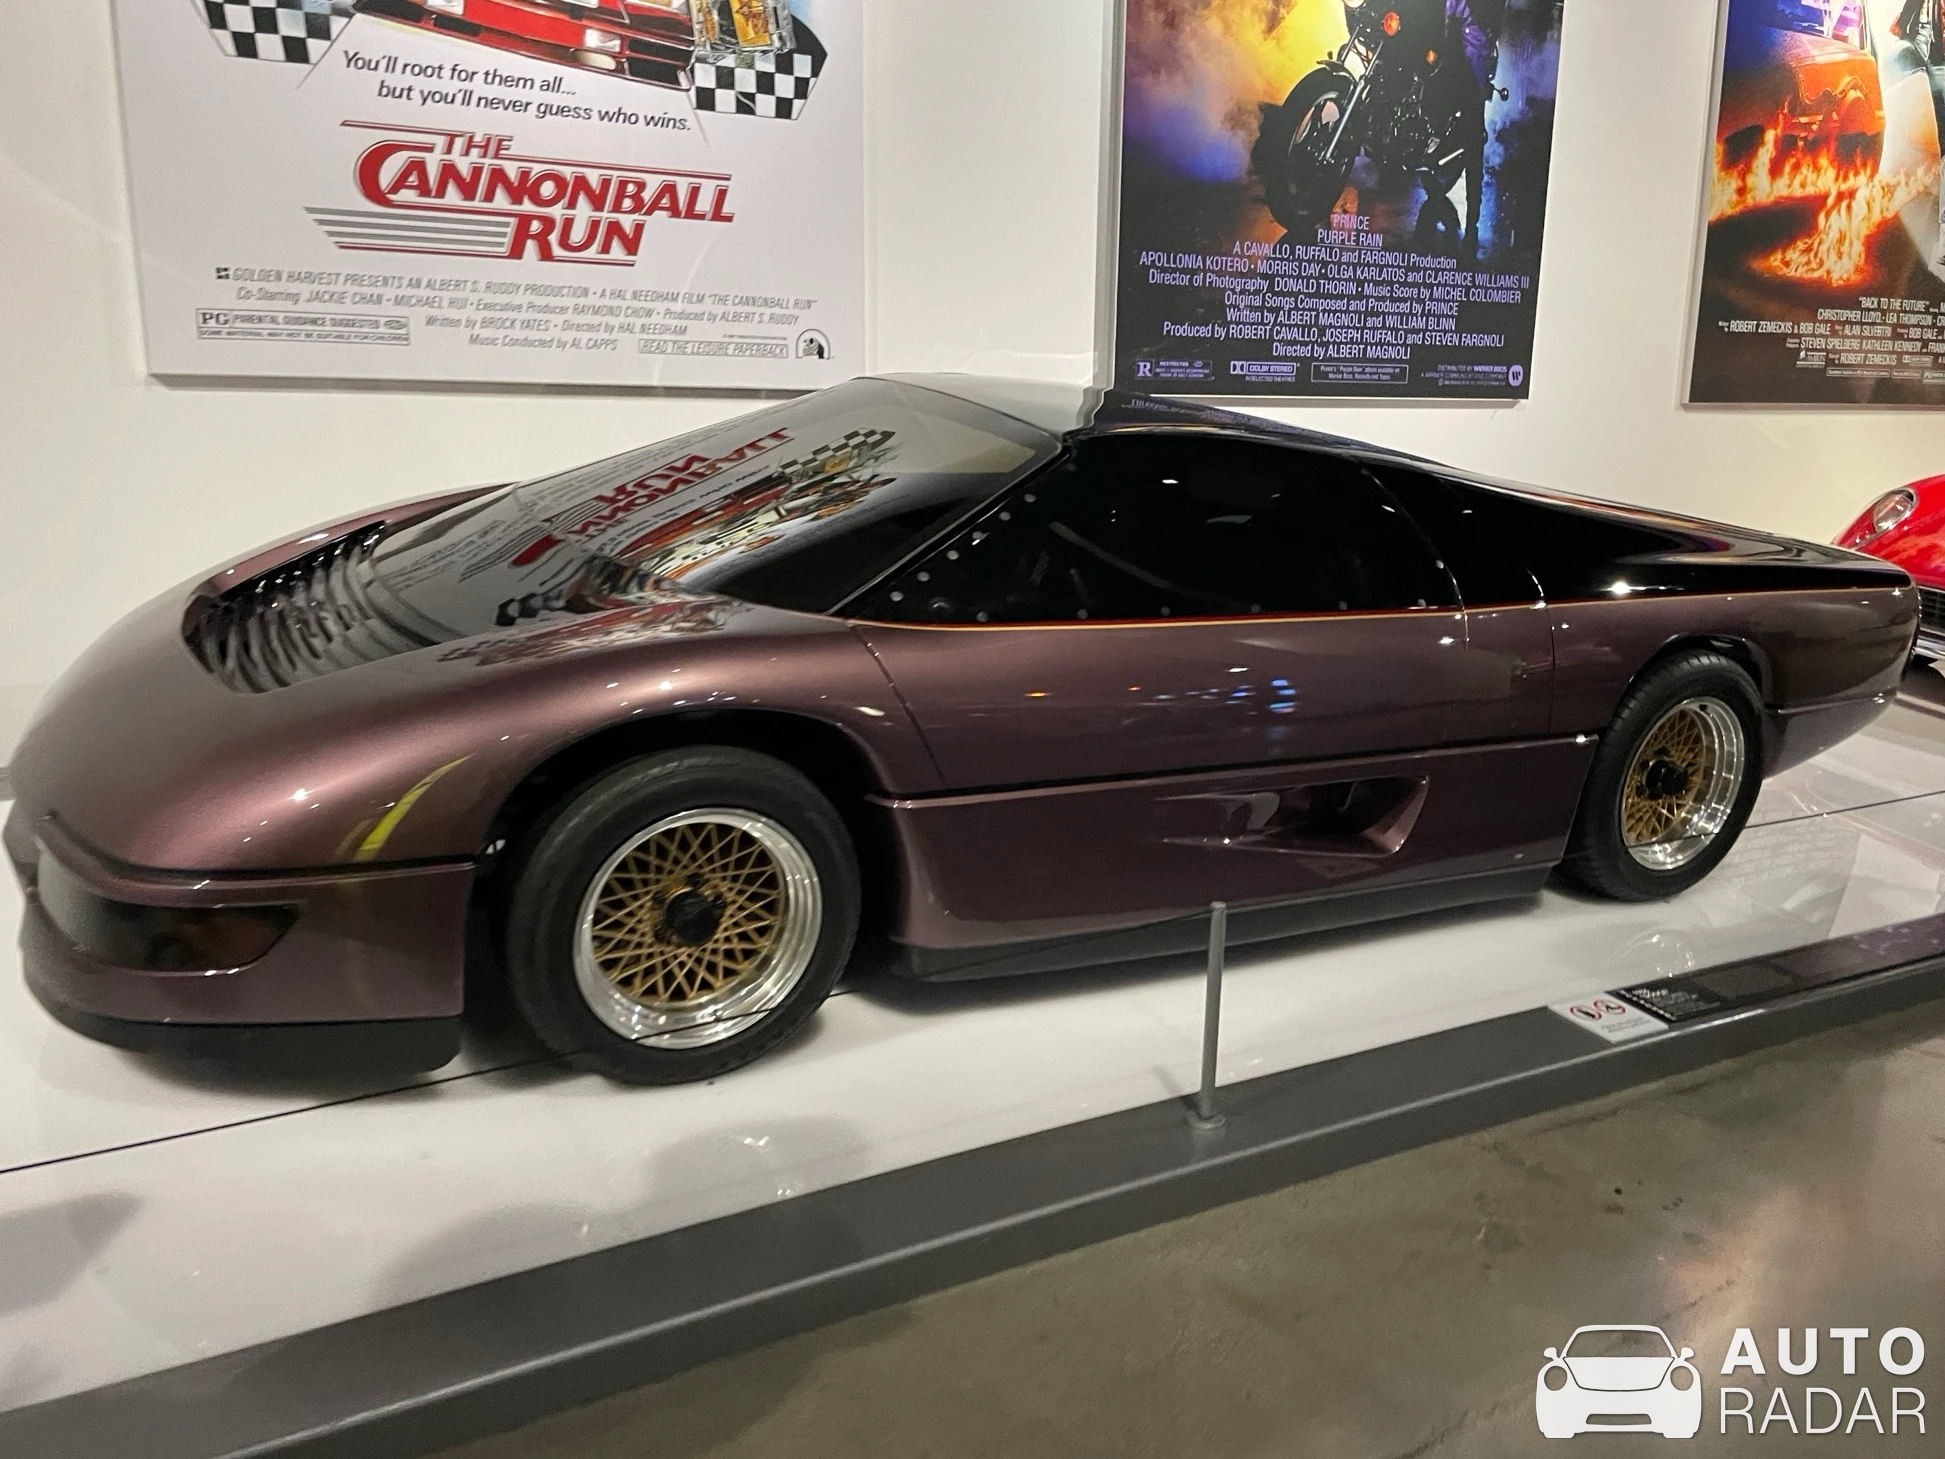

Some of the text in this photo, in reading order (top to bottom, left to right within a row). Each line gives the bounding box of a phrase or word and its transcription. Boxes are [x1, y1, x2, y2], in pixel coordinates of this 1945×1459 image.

[402, 63, 444, 80] root
[450, 64, 478, 84] for
[482, 70, 534, 91] them
[539, 75, 577, 96] all...
[377, 80, 413, 101] but
[477, 95, 532, 114] never
[537, 103, 593, 120] guess
[598, 107, 640, 125] who
[644, 112, 692, 131] wins.
[441, 132, 513, 159] THE
[354, 139, 735, 222] CANNONBALL
[1333, 213, 1370, 231] PRINCE
[504, 212, 647, 262] RUN
[1317, 228, 1383, 247] PURPLE RAIN
[1233, 241, 1457, 269] A CAVALLO, RUFFALO and FARGNOLI Production
[1139, 251, 1530, 289] APOLLONIA KOTERO MORRIS DAY OLGA KARLATOS and CLARENCE WILLIAMS III
[231, 268, 282, 283] GOLDEN
[286, 271, 339, 286] HARVEST
[342, 272, 404, 289] PRESENTS
[406, 275, 423, 289] AN
[424, 275, 470, 292] ALBERT
[483, 281, 521, 295] RUDDY
[523, 283, 590, 298] PRODUCTION
[609, 288, 628, 301] HAL
[631, 289, 681, 304] NEEDHAM
[682, 292, 705, 305] FILM
[731, 295, 790, 310] CANNONBALL
[1149, 268, 1522, 304] Director of Photography DONALD THORIN Music Score by MICHEL COLOMBIER
[235, 286, 302, 305] Co-Starring
[304, 290, 348, 304] JACKIE
[350, 292, 382, 305] CHAN
[392, 294, 445, 309] MICHAEL
[448, 297, 469, 309] HUI
[475, 299, 524, 314] Executive
[525, 301, 569, 315] Producer
[571, 303, 622, 318] RAYMOND
[624, 305, 655, 318] CHOW
[663, 308, 704, 322] Produced
[707, 312, 719, 324] by
[720, 311, 757, 323] ALBERT
[768, 312, 800, 326] RUDDY
[1224, 290, 1459, 316] Original Songs Composed and Produced by PRINCE
[1880, 297, 1889, 309] TO
[1889, 298, 1902, 310] THE
[201, 312, 230, 326] PG
[424, 314, 688, 337] Written by BROCK YATES Directed by HAL NEEDHAM
[1226, 308, 1456, 331] Written by ALBERT MAGNOLI and WILLIAM BLINN
[1817, 308, 1933, 326] CHRISTOPHER LEA THOMPSON
[1163, 321, 1505, 348] Produced by ROBERT CAVALLO, JOSEPH RUFFALO and STEVEN FARGNOLI
[1730, 320, 1757, 333] ROBERT
[1758, 321, 1793, 334] ZEMECKIS
[1799, 323, 1813, 335] BOB
[1814, 323, 1831, 335] GALE
[1843, 324, 1861, 336] ALAN
[1908, 327, 1921, 339] BOB
[1922, 328, 1938, 340] GALE
[468, 333, 619, 351] Music Conducted by AL CAPPS
[641, 341, 786, 357] READ THE LEISURE PAPERBACK
[1272, 342, 1411, 360] Directed by ALBERT MAGNOLI
[1800, 337, 1826, 350] STEVEN
[1826, 338, 1860, 350] SPIELBERG
[1861, 339, 1893, 351] KATHLEEN
[1893, 341, 1922, 353] KENNEDY
[1839, 352, 1865, 364] ROBERT
[1865, 353, 1897, 366] ZEMECKIS
[1137, 361, 1152, 377] R
[1249, 365, 1270, 373] DOLBY
